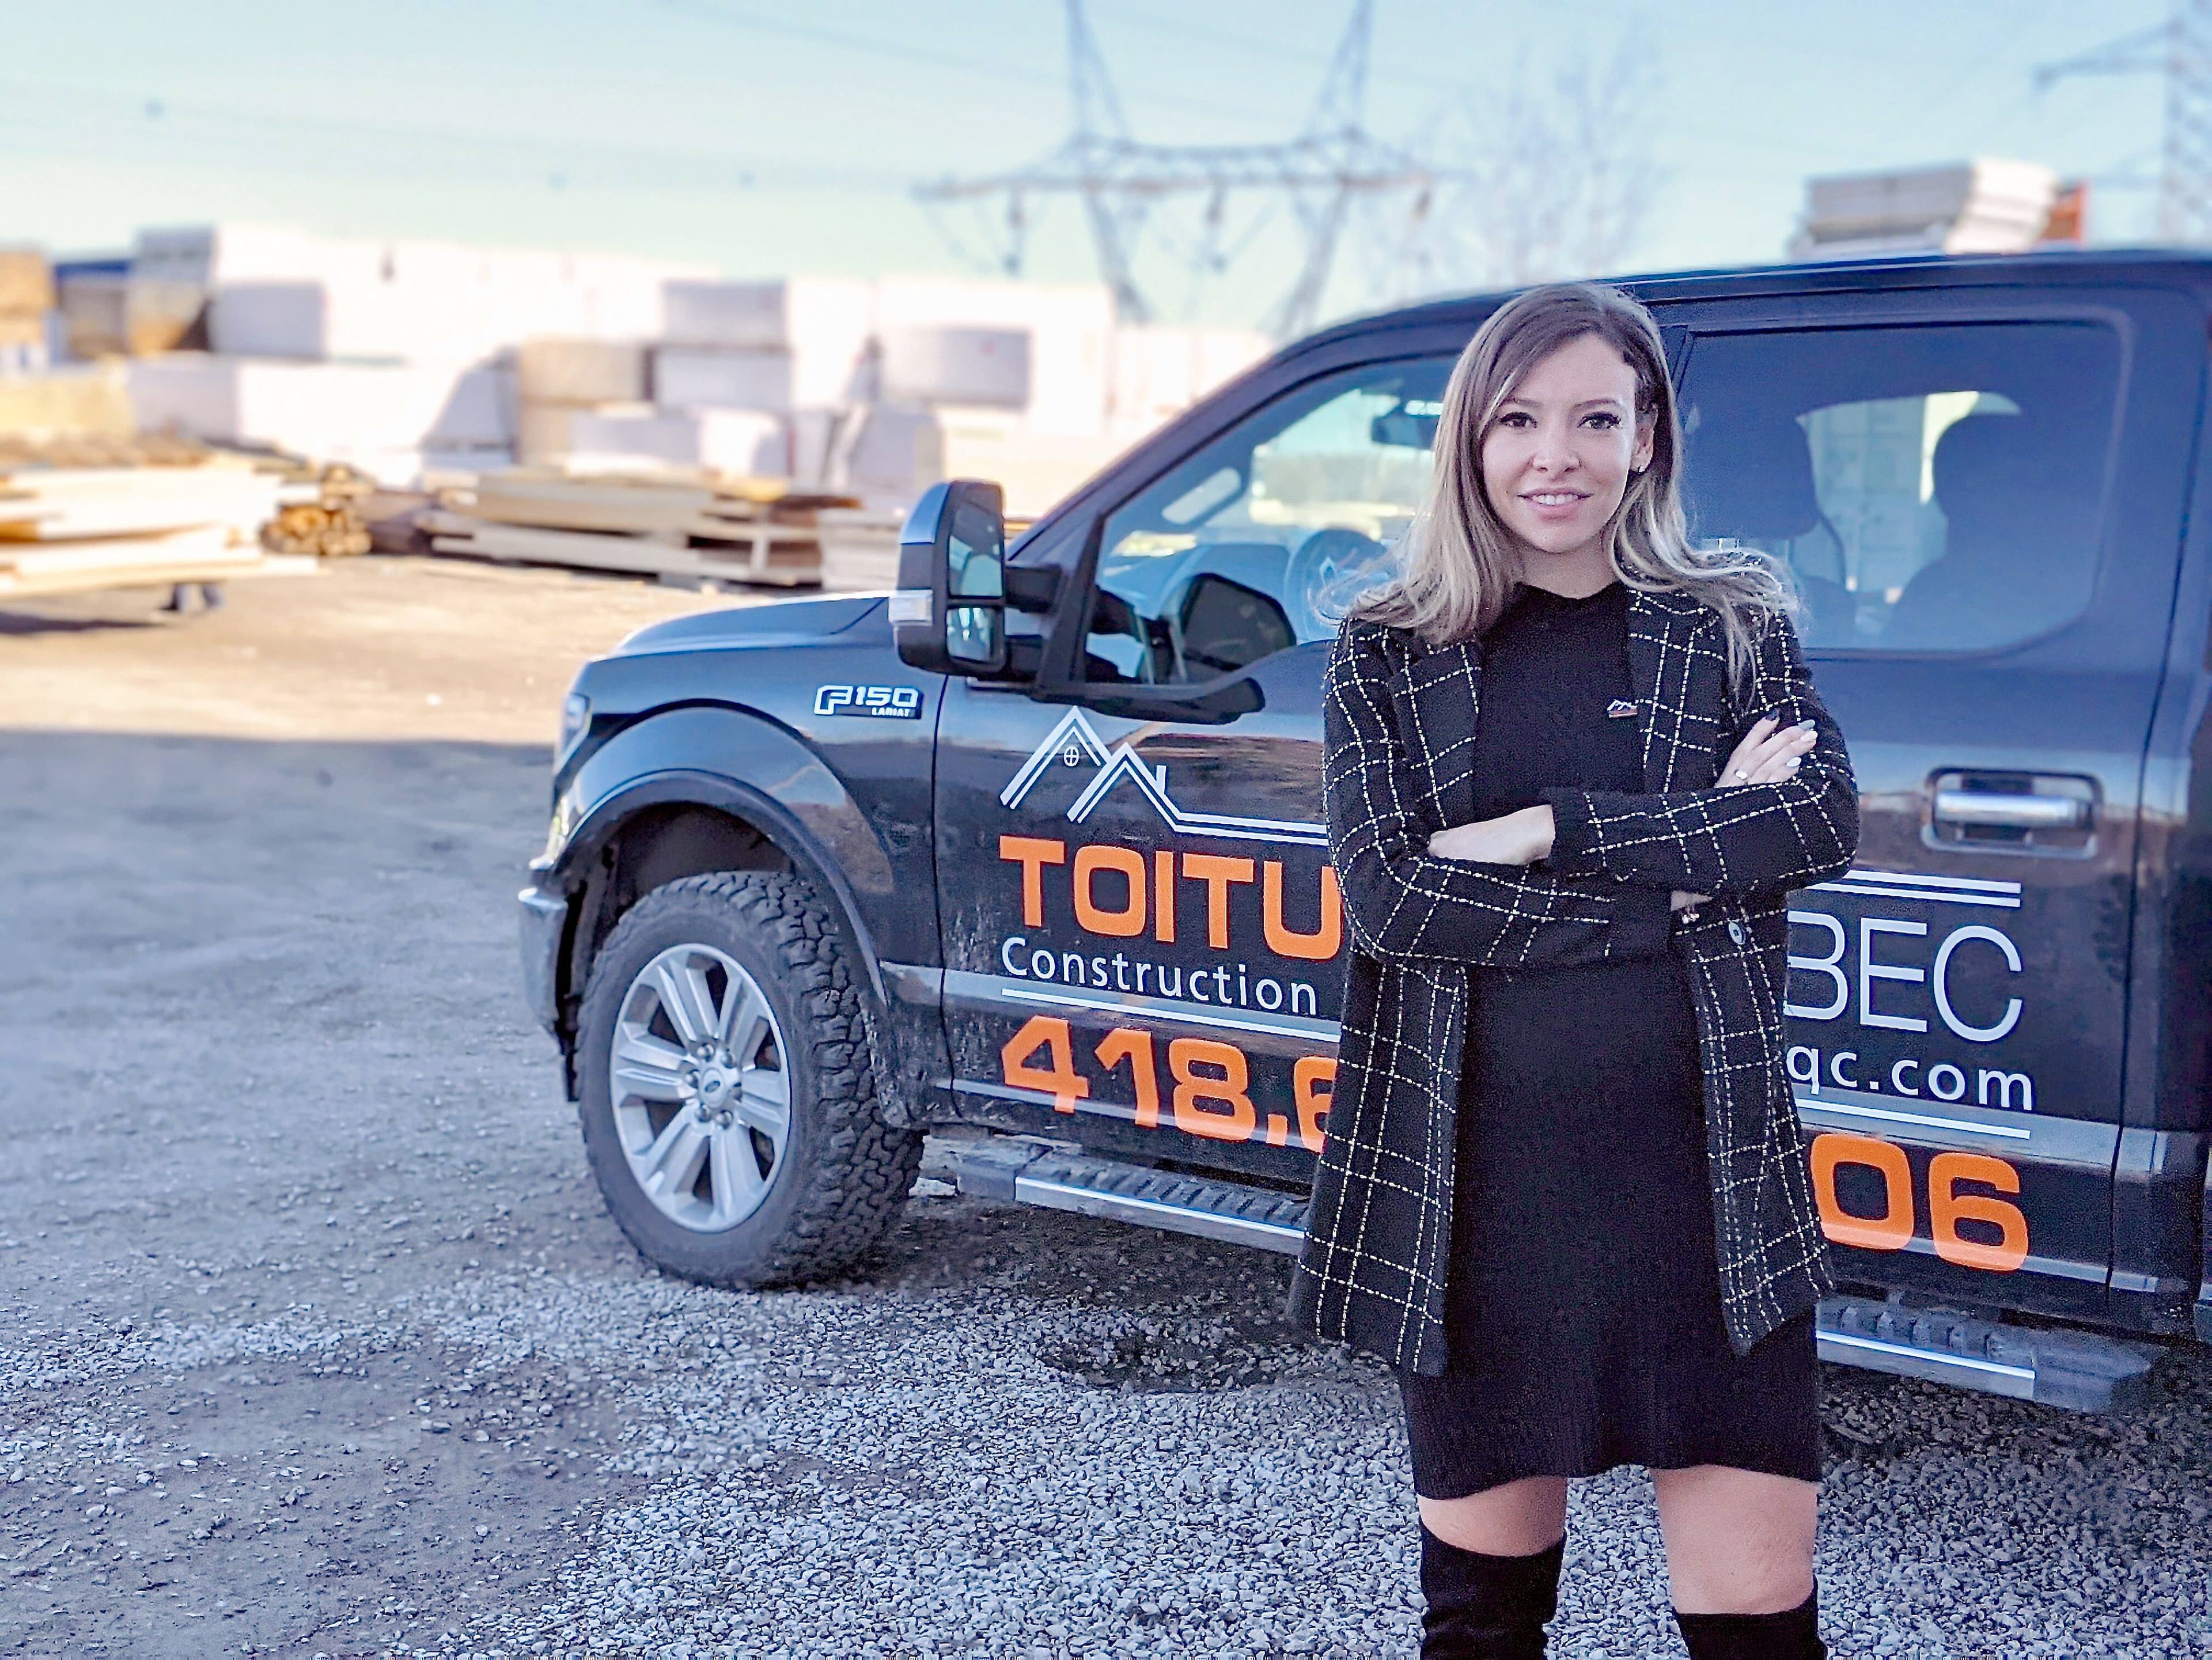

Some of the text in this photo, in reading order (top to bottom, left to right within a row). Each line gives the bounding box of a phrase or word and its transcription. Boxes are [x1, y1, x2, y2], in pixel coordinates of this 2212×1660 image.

[1000, 835, 2022, 1042] TOITU BEC
[1002, 937, 2032, 1111] Construction qc.com
[1810, 1133, 2029, 1271] 06
